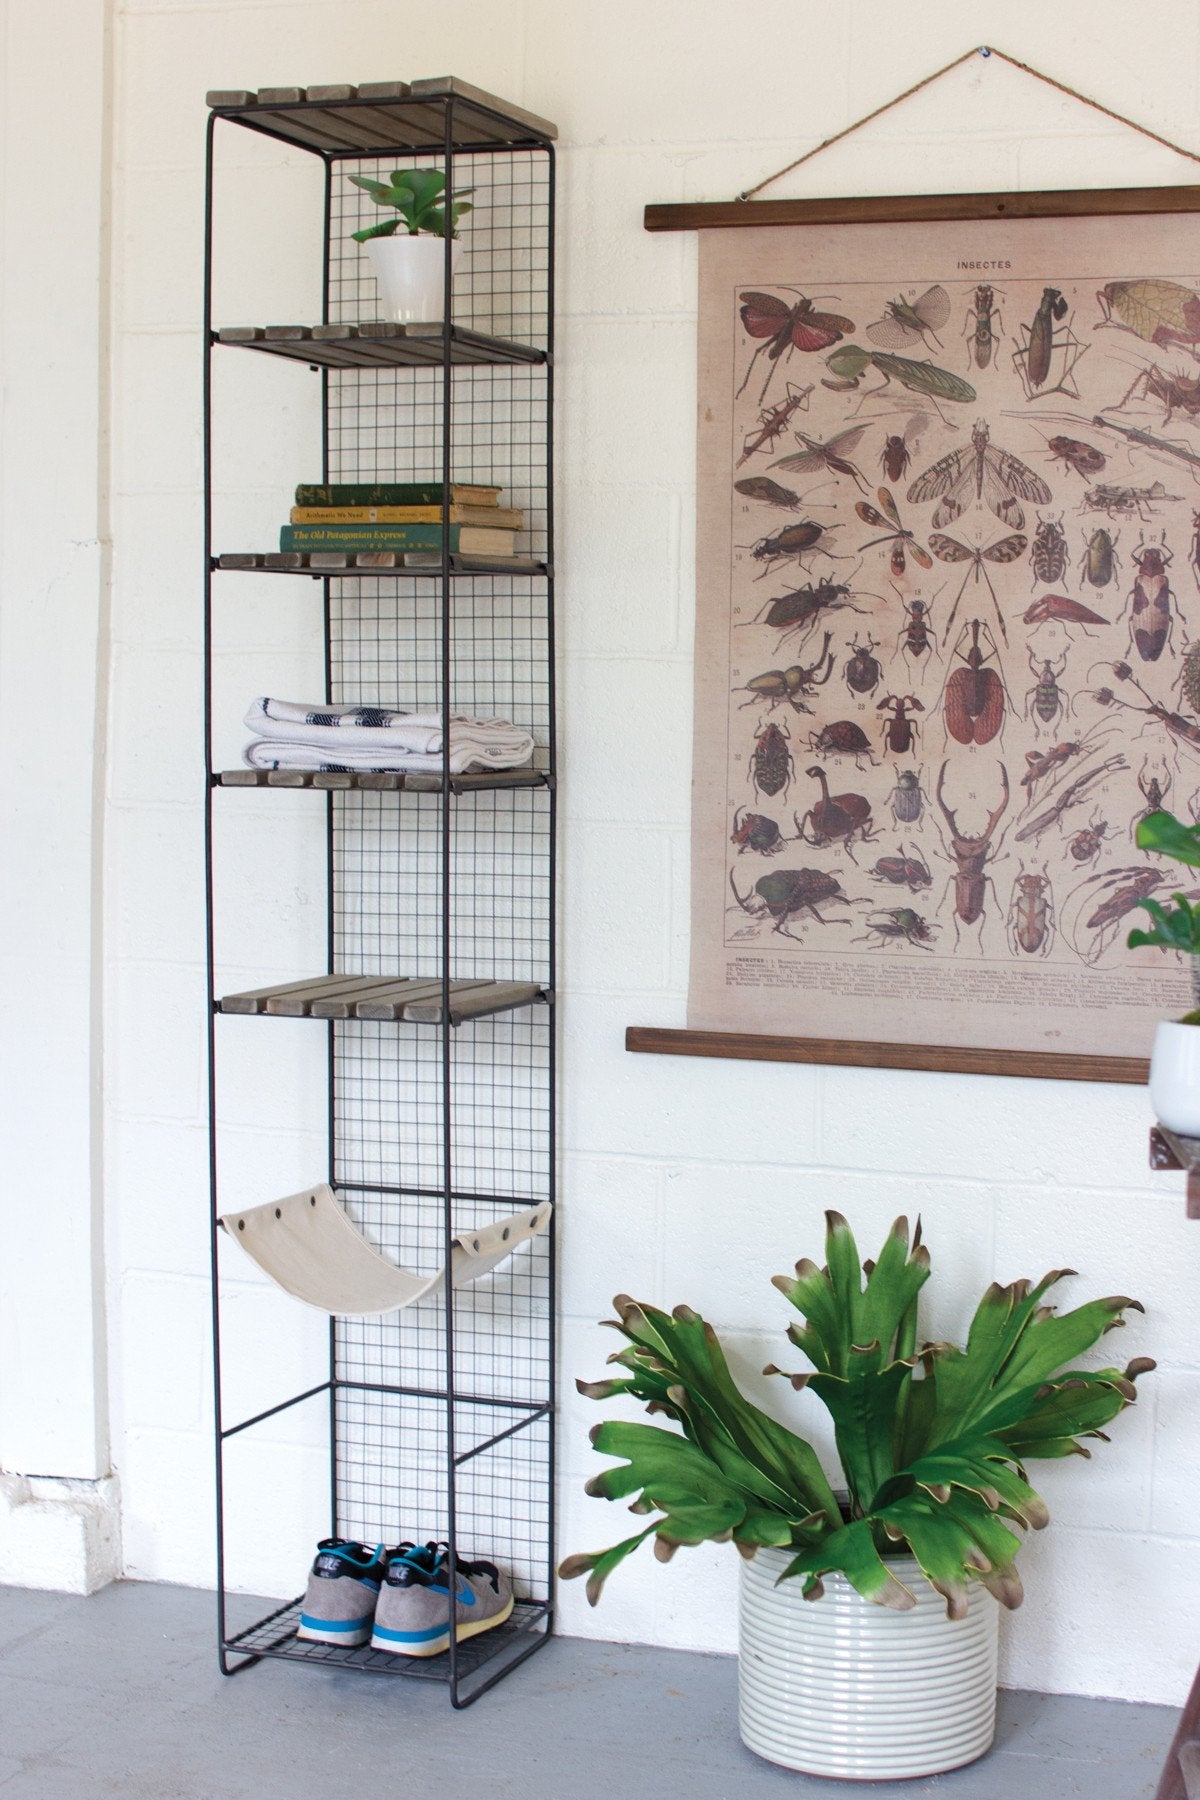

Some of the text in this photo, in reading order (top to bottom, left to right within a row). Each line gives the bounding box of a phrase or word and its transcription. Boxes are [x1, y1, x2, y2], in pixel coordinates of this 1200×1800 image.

[957, 261, 1012, 270] INSECTES
[908, 289, 917, 297] 10
[293, 531, 406, 541] The Old Patagonian Express
[733, 606, 741, 614] 20
